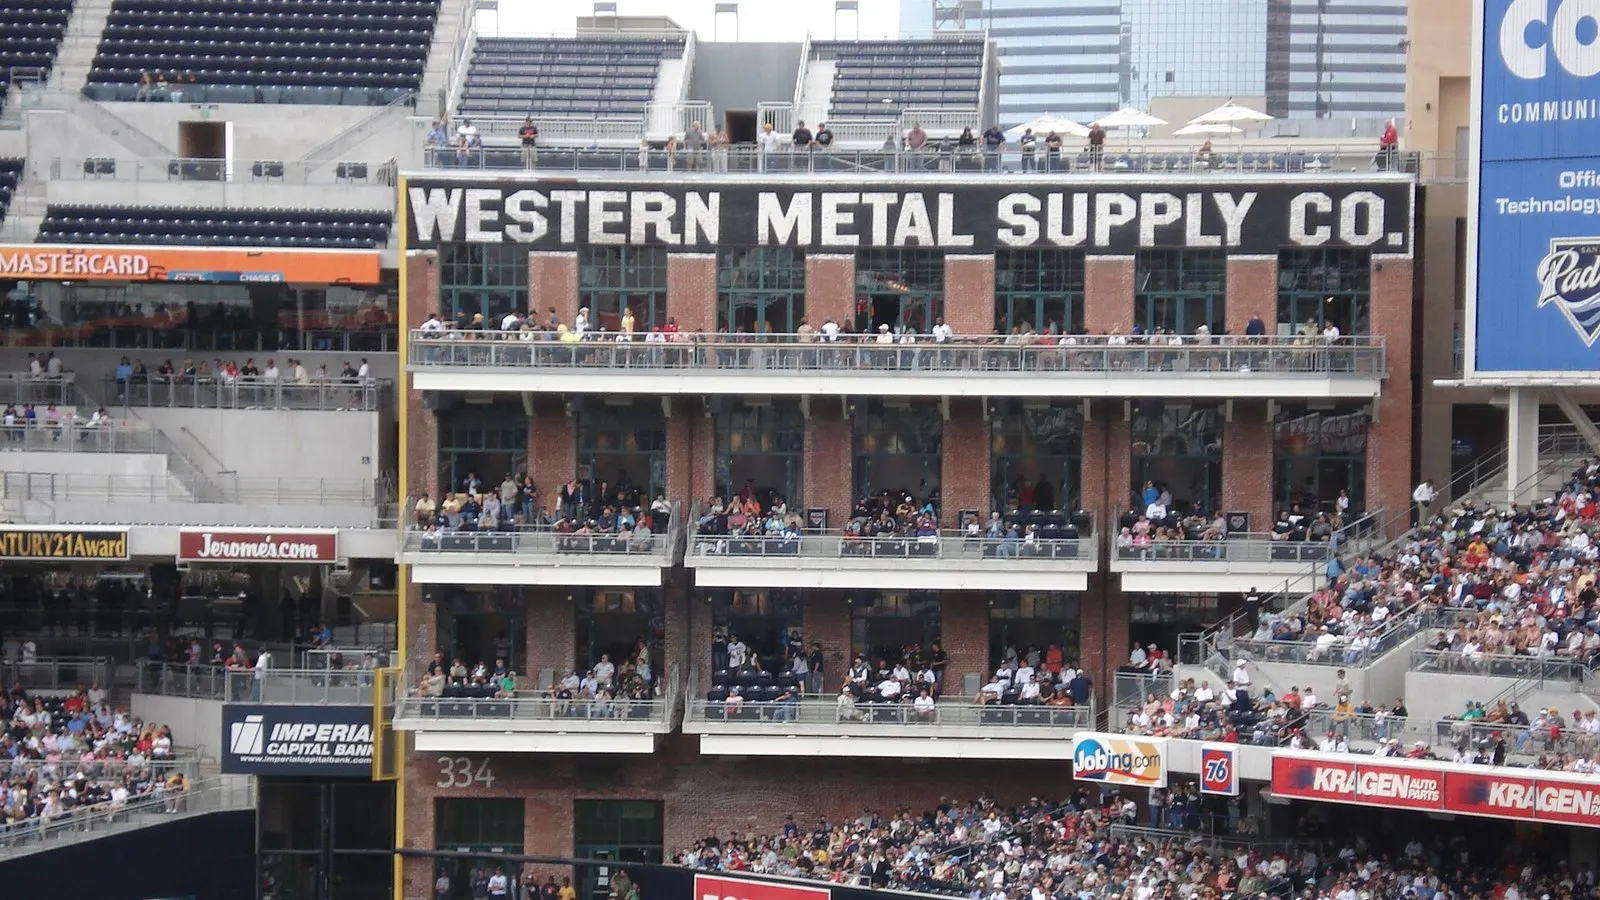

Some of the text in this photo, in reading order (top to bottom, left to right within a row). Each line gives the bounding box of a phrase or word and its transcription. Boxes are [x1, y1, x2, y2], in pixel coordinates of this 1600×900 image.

[1500, 0, 1600, 79] CO
[1498, 98, 1600, 124] COMMUNI
[408, 186, 1404, 247] WESTERN METAL SUPPLY CO.
[0, 252, 149, 275] MASTERCARD
[270, 723, 374, 743] IMPERIA
[266, 743, 331, 756] CAPITAL
[1074, 749, 1160, 773] Jobing.com
[436, 756, 496, 789] 334
[1205, 758, 1229, 783] 76
[1313, 767, 1438, 799] KRAGEN AUTO
[1407, 789, 1440, 802] PARTS
[1488, 782, 1593, 816] KRAGEN
